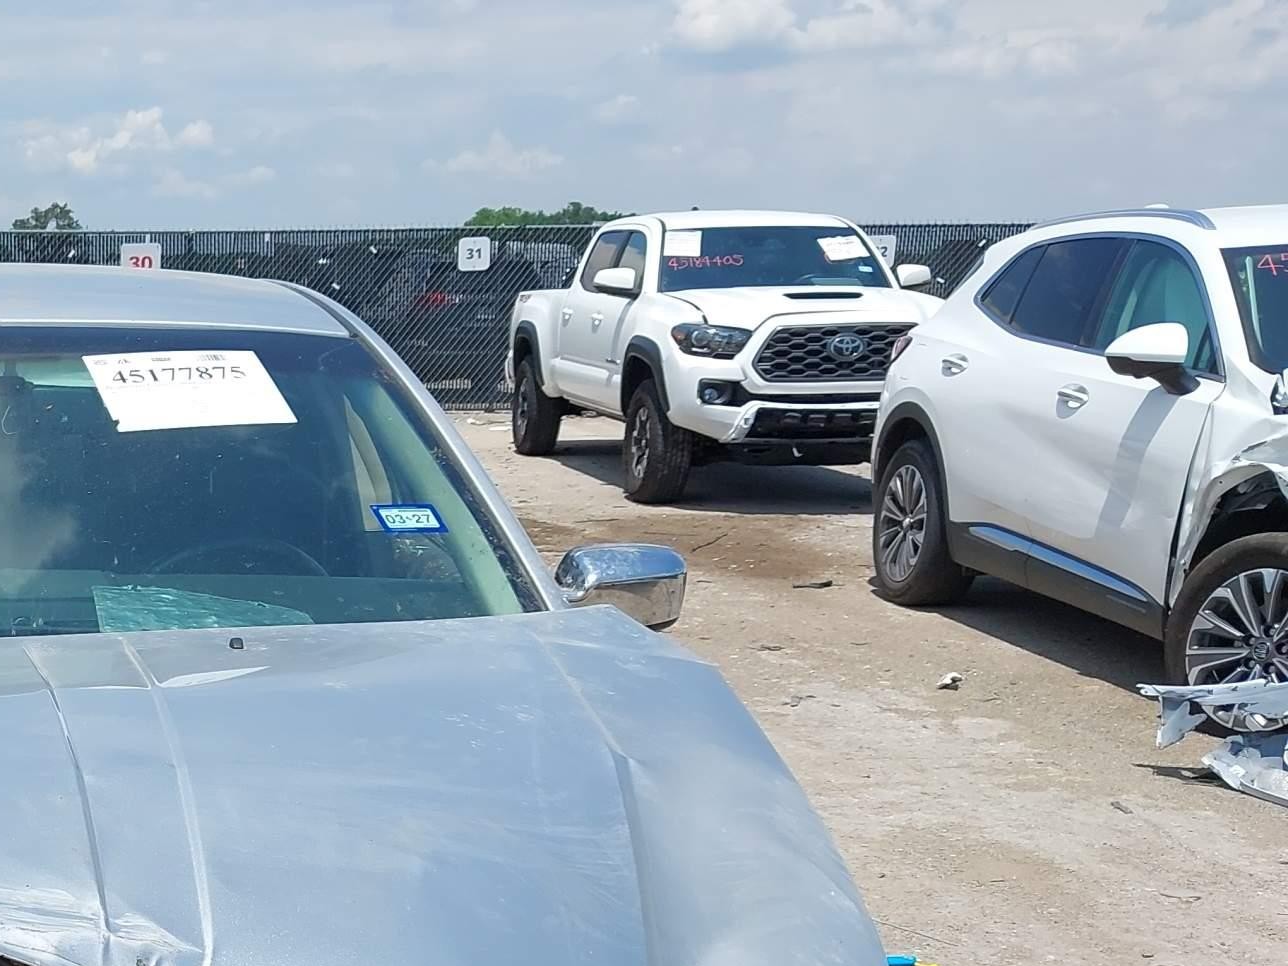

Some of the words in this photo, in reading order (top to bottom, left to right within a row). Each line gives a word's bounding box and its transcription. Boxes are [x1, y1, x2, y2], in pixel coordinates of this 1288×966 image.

[465, 247, 482, 260] 31
[876, 245, 890, 258] 2
[128, 255, 153, 269] 30
[112, 366, 247, 384] 45177875
